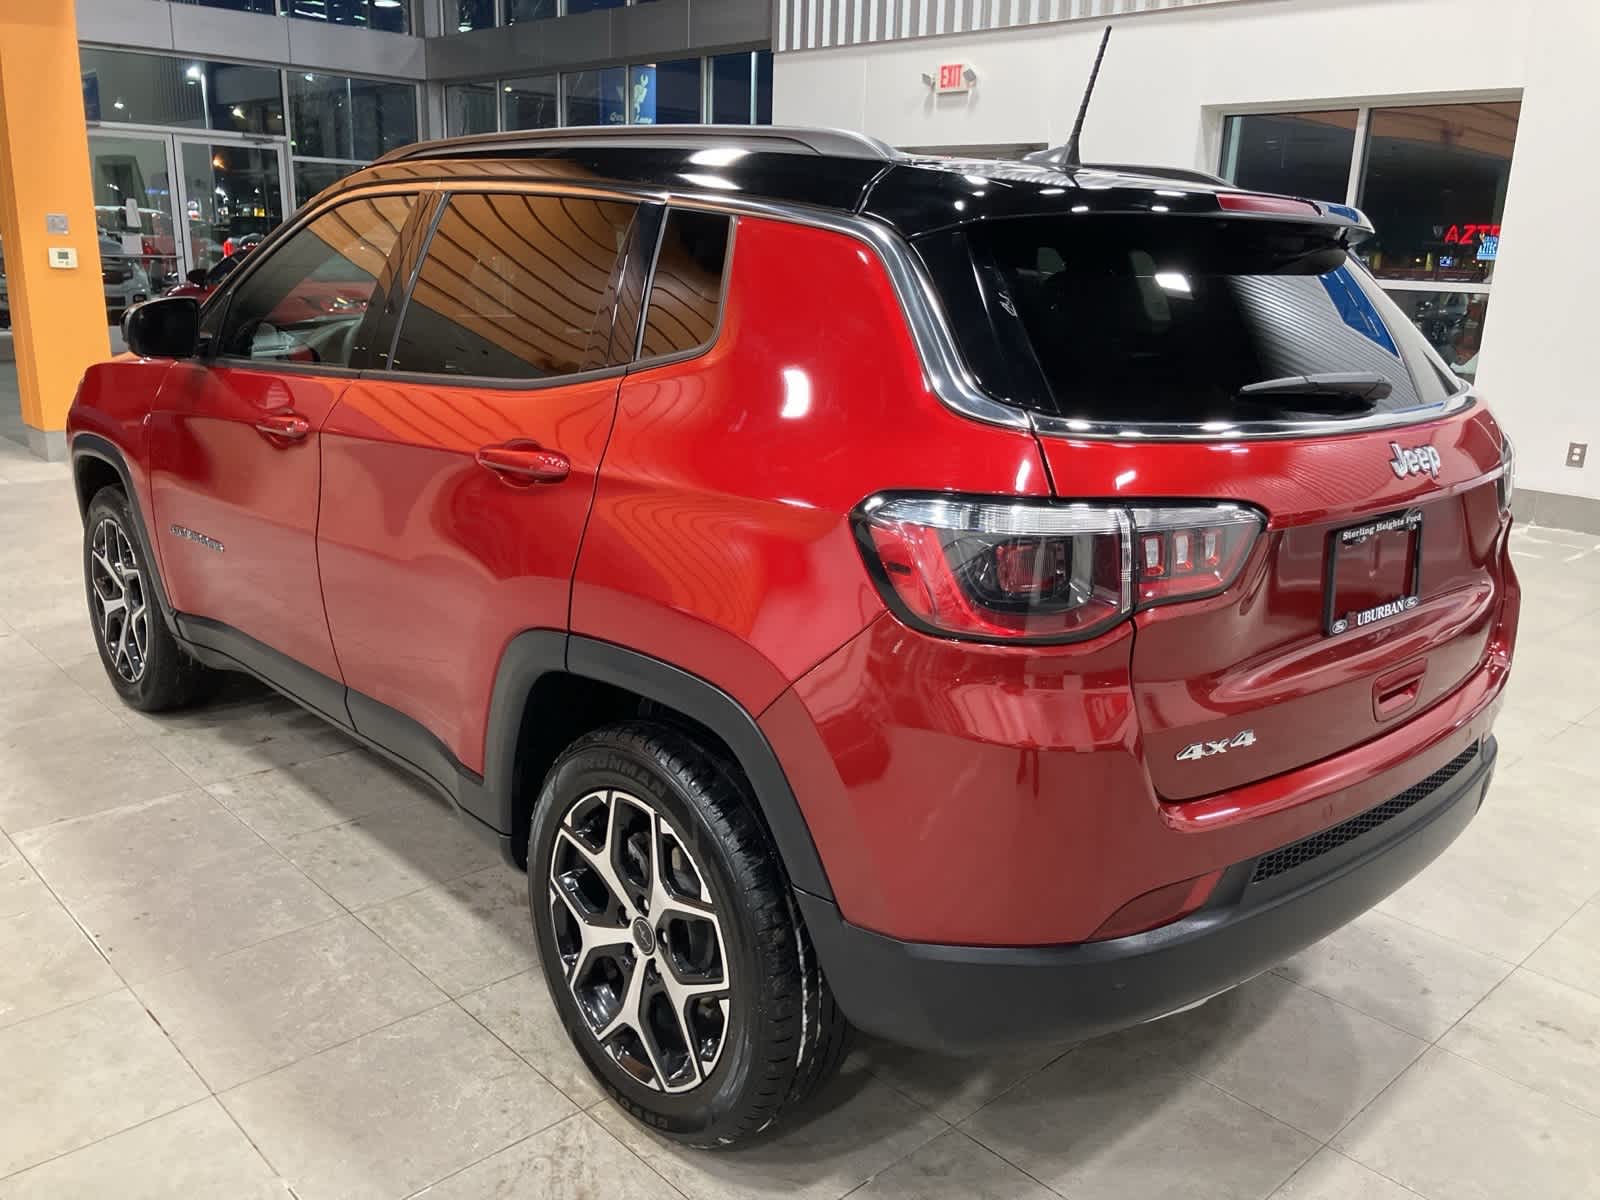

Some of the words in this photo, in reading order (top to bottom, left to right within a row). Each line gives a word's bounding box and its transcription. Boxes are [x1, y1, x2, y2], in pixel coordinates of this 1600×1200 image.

[940, 64, 962, 88] EXIT
[1390, 443, 1440, 479] Jeep
[1342, 525, 1375, 540] Sterling
[1376, 518, 1404, 532] Heights
[1405, 512, 1422, 525] Ford
